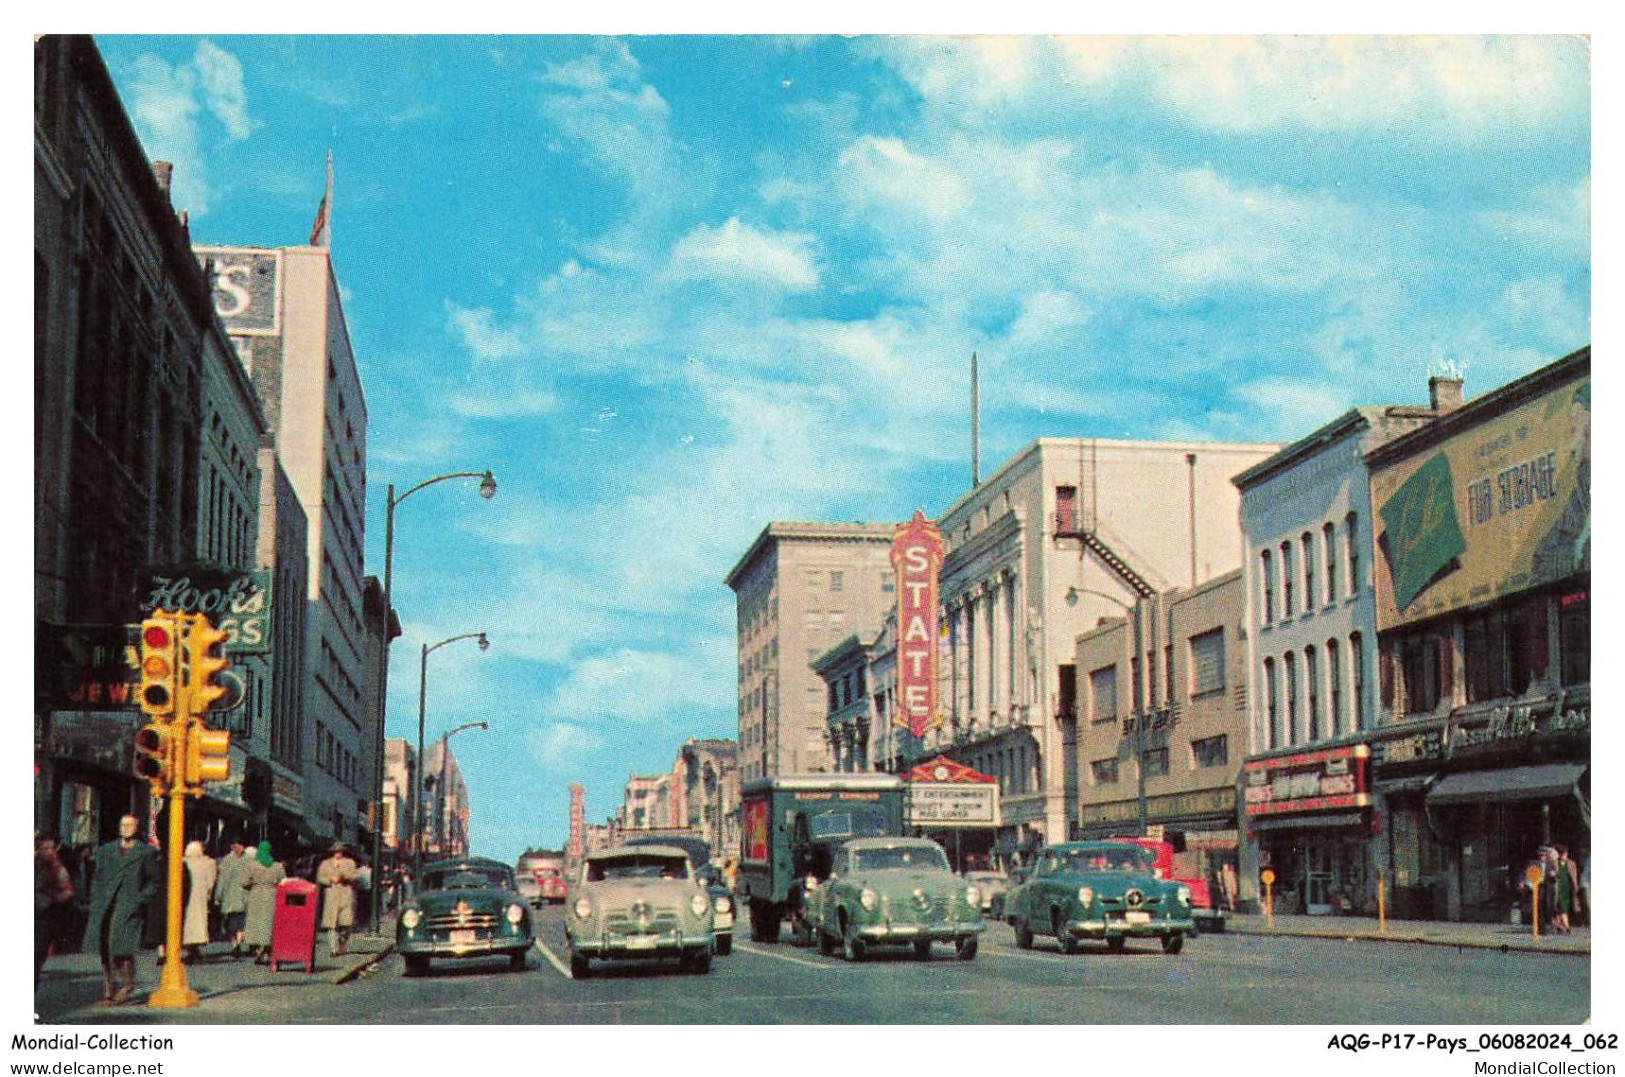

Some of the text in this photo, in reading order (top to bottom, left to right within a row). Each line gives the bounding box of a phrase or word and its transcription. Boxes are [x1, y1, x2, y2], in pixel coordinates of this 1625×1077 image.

[1468, 451, 1558, 527] FUR STORAGE
[905, 546, 929, 713] STATE
